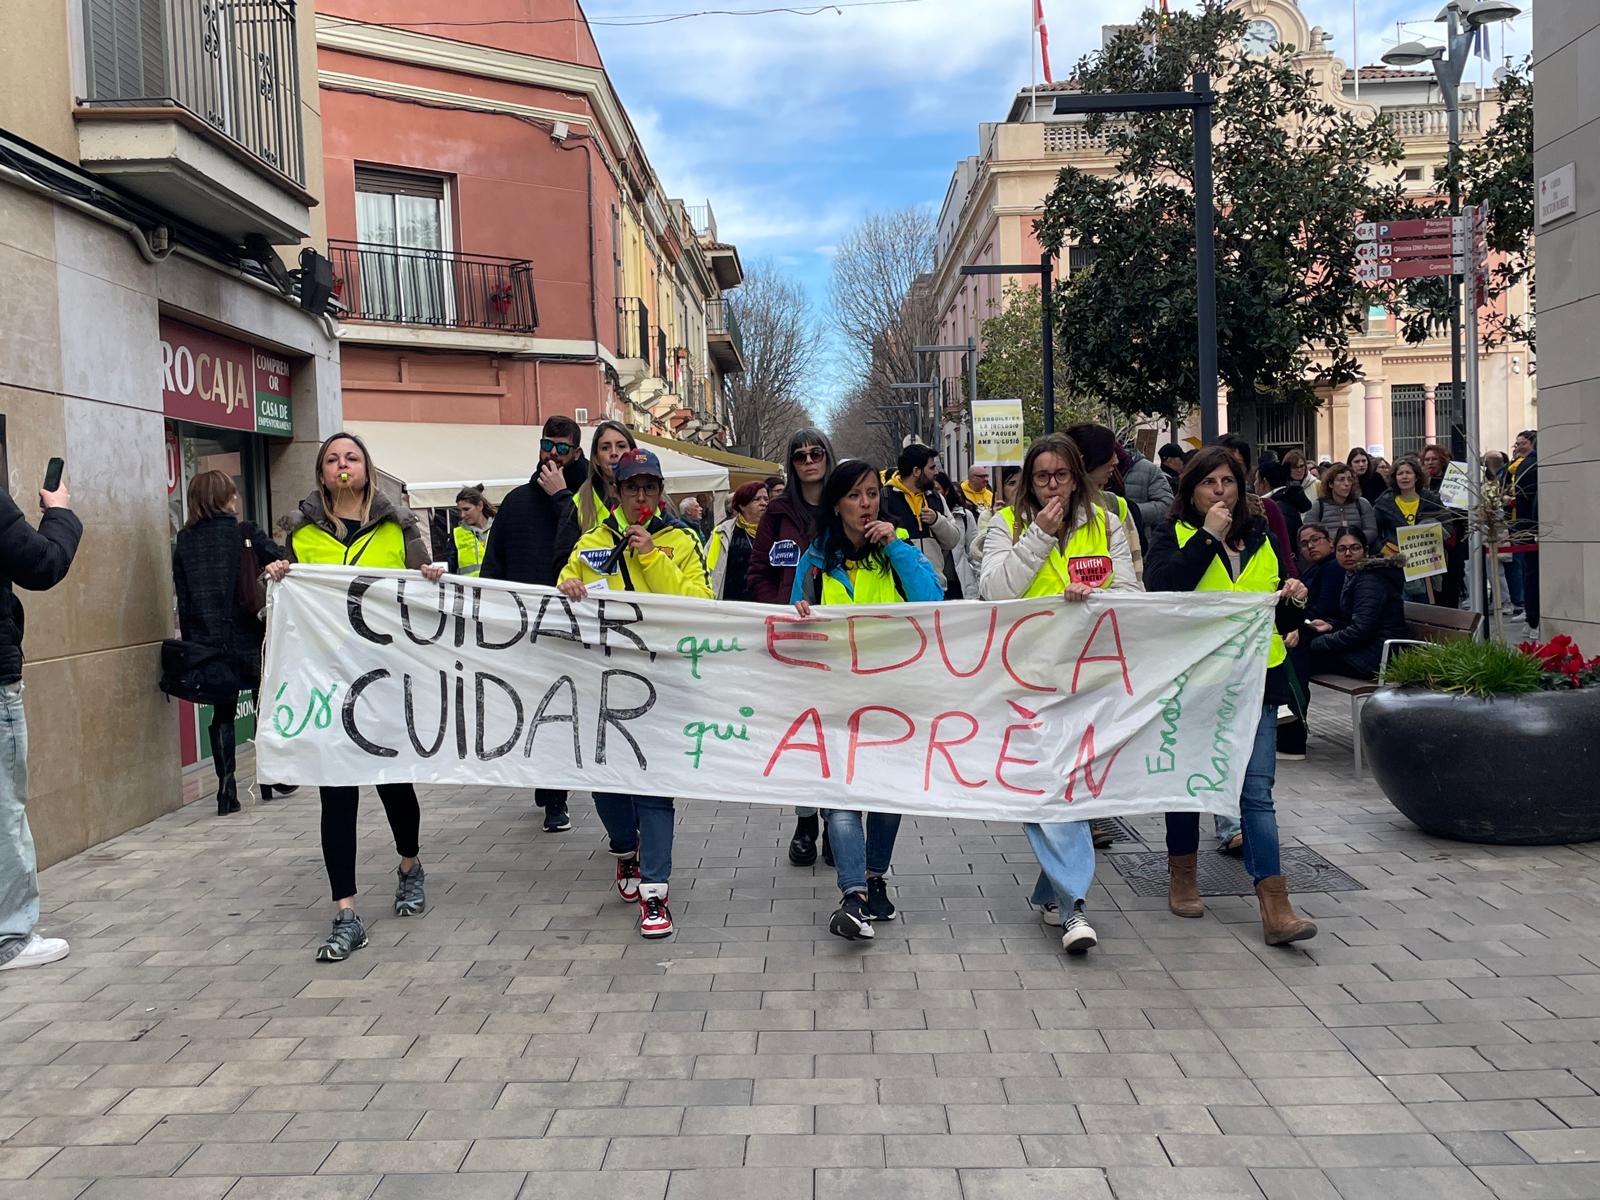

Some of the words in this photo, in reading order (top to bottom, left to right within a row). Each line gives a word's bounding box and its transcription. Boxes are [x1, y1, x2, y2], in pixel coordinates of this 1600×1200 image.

[256, 355, 289, 376] COMPREM
[268, 375, 280, 391] OR
[261, 400, 278, 418] CASA
[279, 404, 288, 419] DE
[1076, 559, 1103, 570] LLUITEM
[347, 576, 656, 662] CUIDAR
[765, 606, 1133, 696] EDUCA
[1186, 682, 1246, 798] Ramon
[683, 706, 755, 769] qui
[763, 700, 1127, 803] APRÈN
